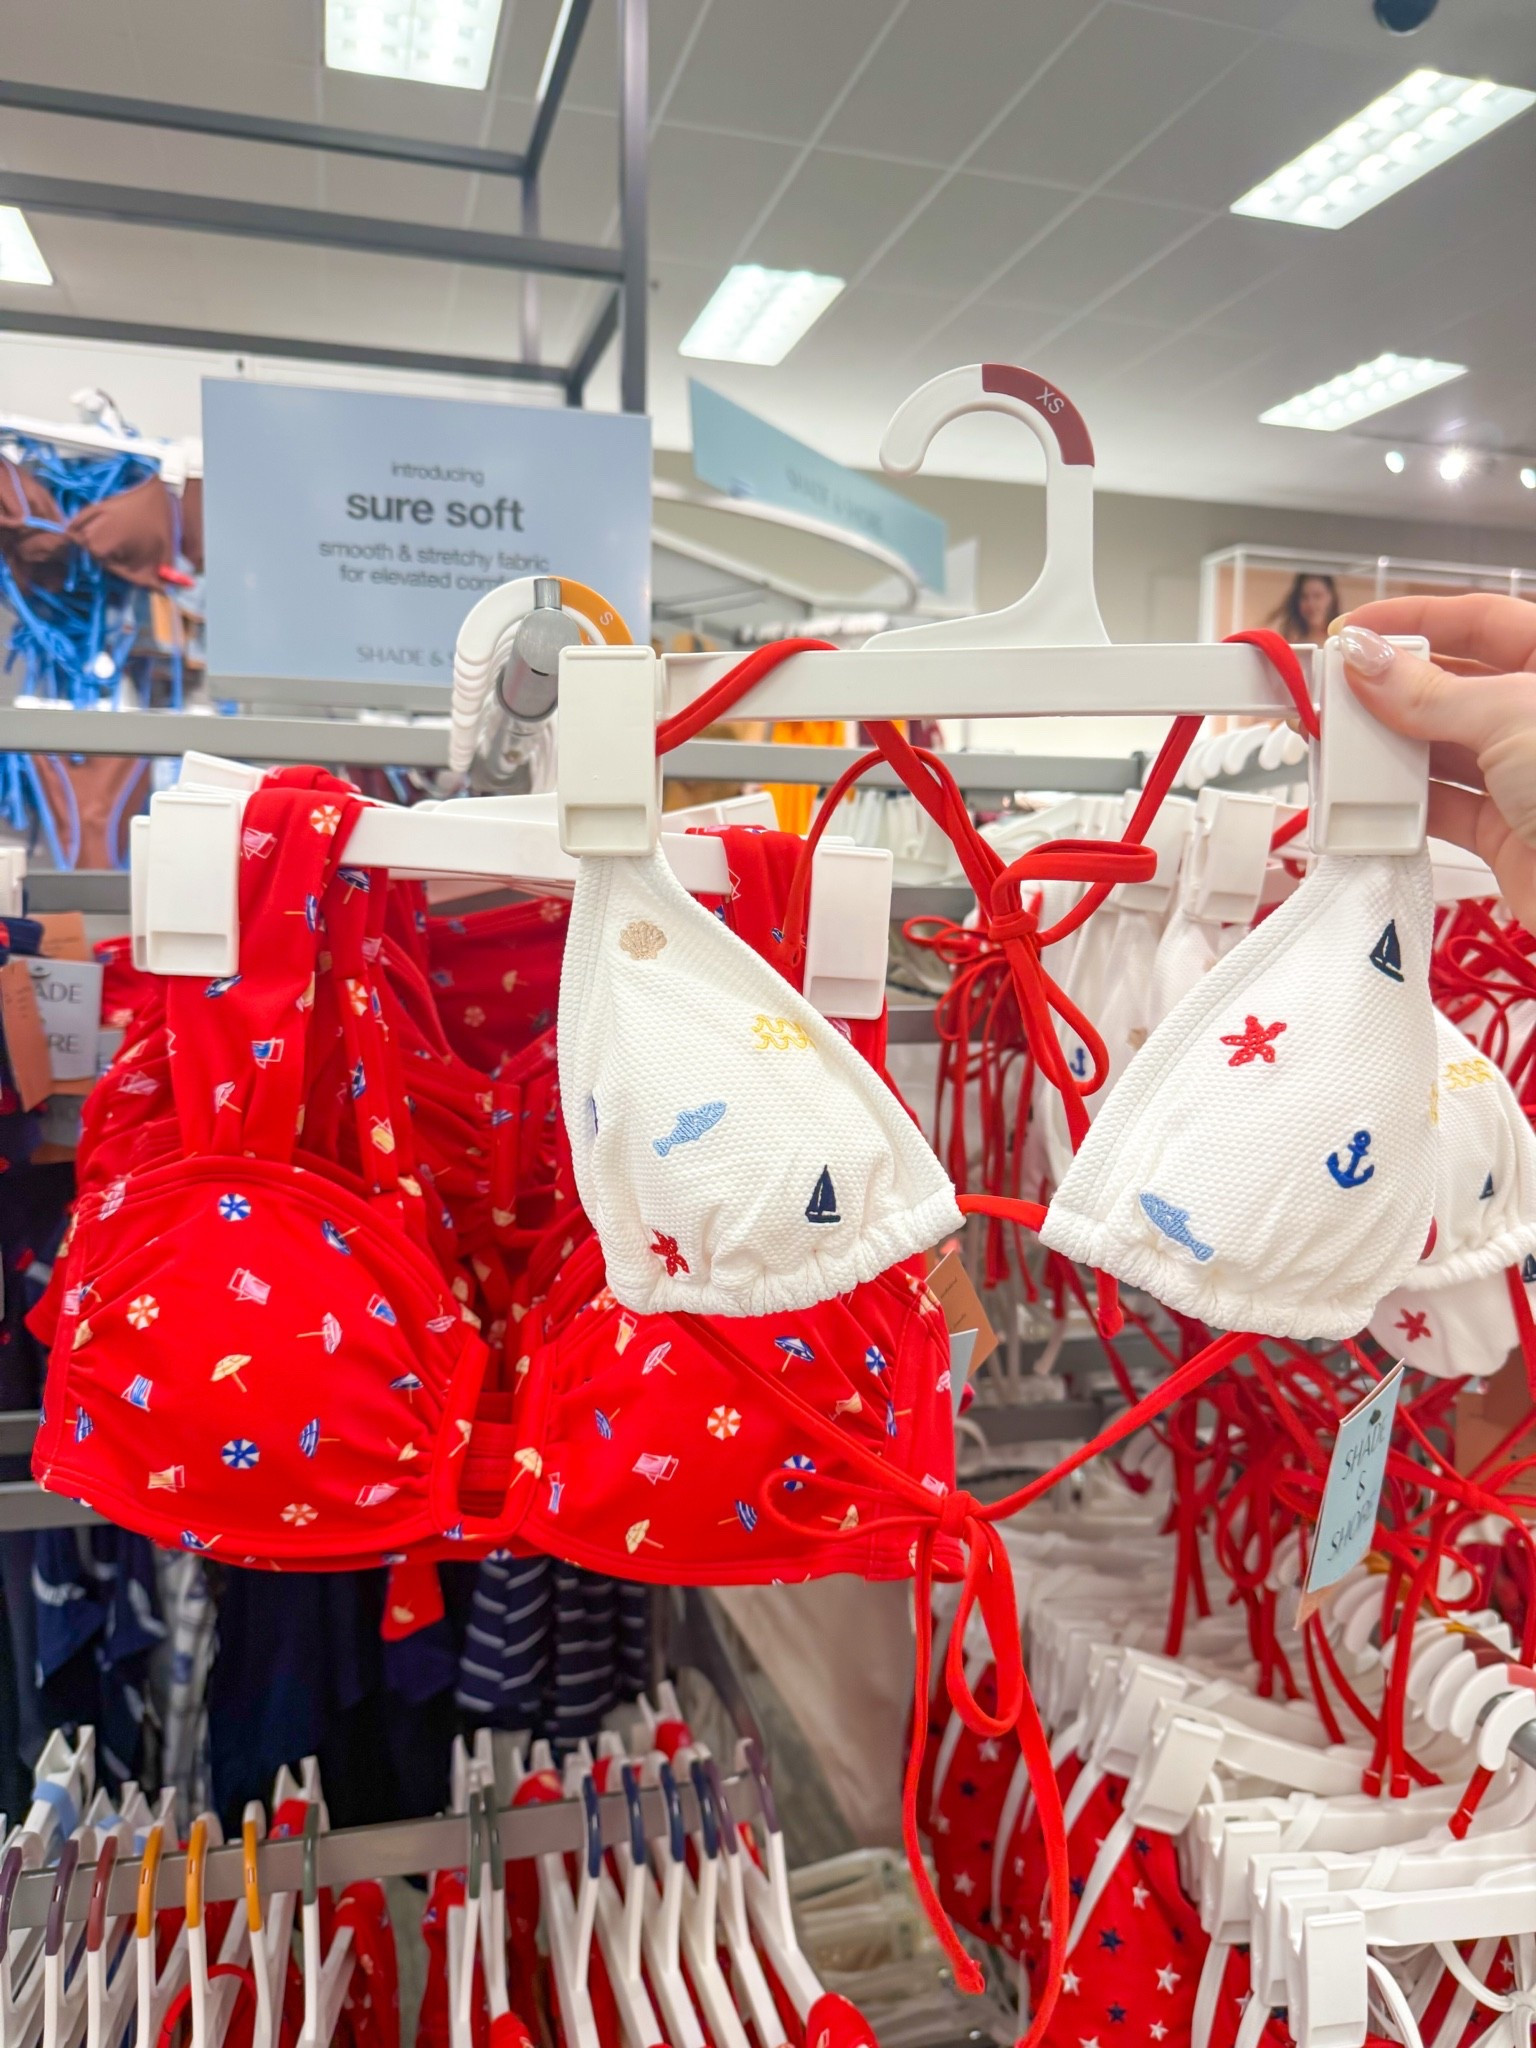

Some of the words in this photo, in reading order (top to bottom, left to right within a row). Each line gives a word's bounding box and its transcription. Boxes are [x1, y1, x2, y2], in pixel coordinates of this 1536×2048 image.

[1036, 386, 1065, 414] XS
[391, 461, 485, 488] introducing
[346, 493, 435, 525] sure
[446, 496, 525, 533] soft
[318, 541, 394, 560] smooth
[399, 544, 412, 563] &
[416, 547, 493, 572] stretchy
[499, 550, 550, 573] fabric
[339, 564, 365, 584] for
[369, 566, 452, 590] elevated
[599, 611, 614, 626] S
[356, 646, 425, 667] SHADE
[430, 650, 444, 668] &
[34, 981, 82, 1003] ADE
[1341, 1414, 1387, 1480] SHADE
